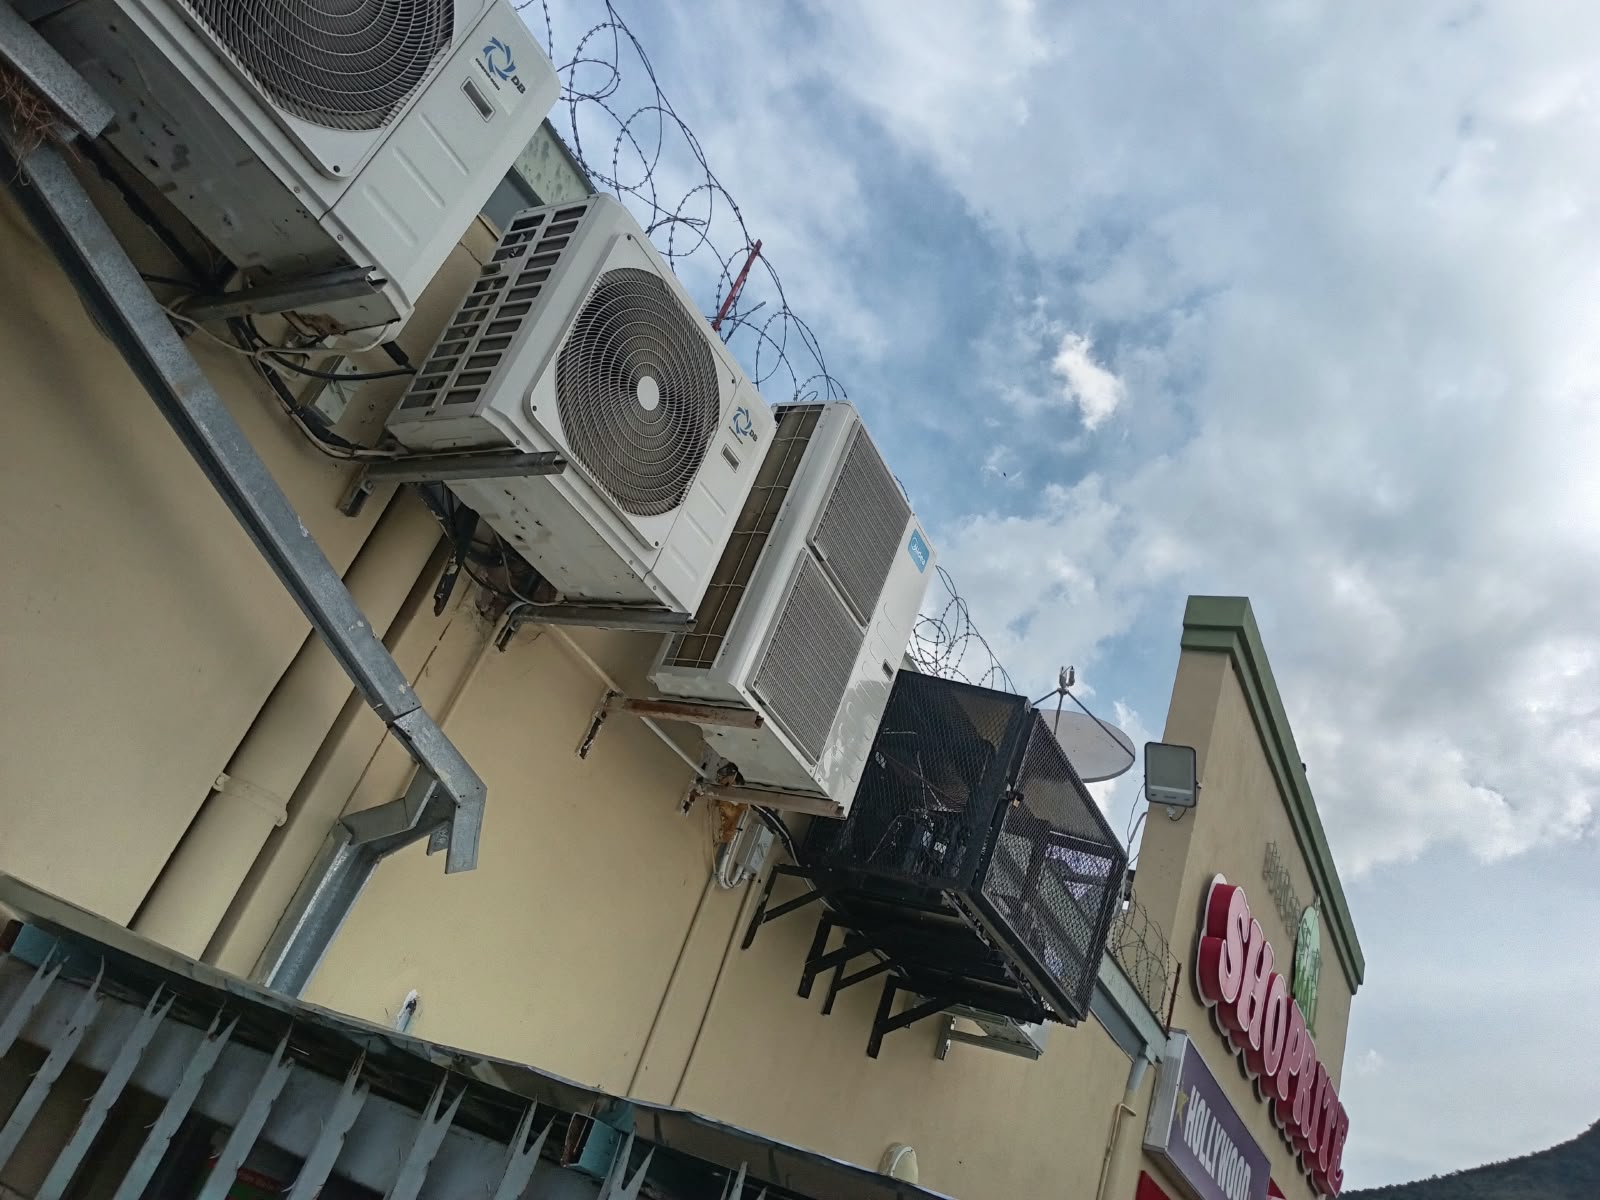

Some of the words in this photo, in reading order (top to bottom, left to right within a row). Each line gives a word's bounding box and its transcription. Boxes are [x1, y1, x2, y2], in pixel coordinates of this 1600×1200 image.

[511, 75, 526, 94] DB
[1215, 885, 1350, 1199] SHOPRITE
[1183, 1085, 1252, 1200] HOLLYWOOD
